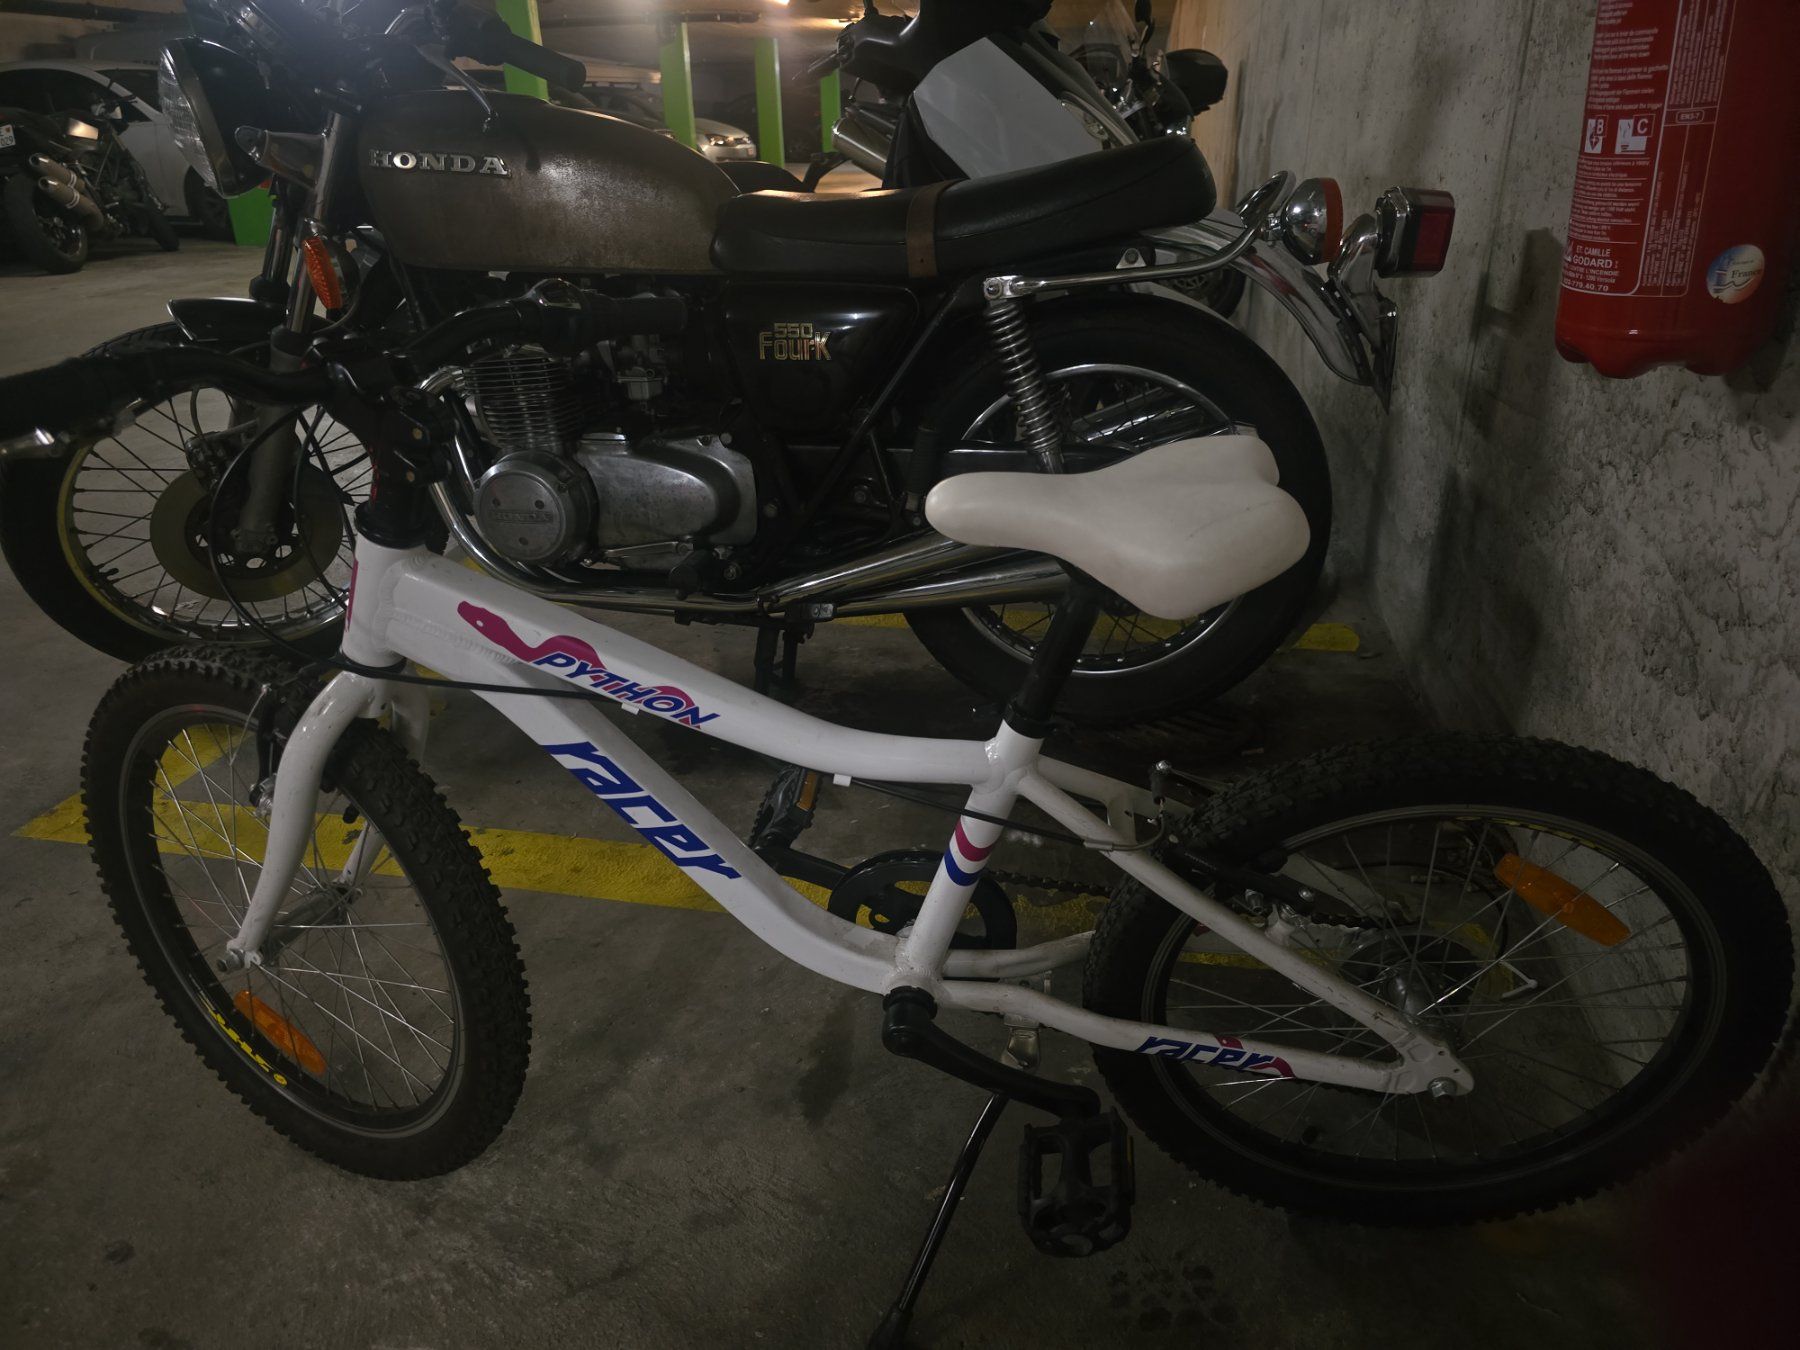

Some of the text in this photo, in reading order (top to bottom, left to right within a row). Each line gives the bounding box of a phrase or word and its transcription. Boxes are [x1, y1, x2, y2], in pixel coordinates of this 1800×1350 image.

[1596, 118, 1605, 134] B
[1636, 118, 1649, 134] C
[368, 149, 510, 177] HONDA
[1584, 247, 1611, 257] CAMILLE
[1572, 254, 1613, 269] GODARD
[772, 322, 813, 338] 550
[534, 652, 719, 727] PYTHON
[543, 741, 741, 880] racer
[1136, 1036, 1273, 1072] racer
